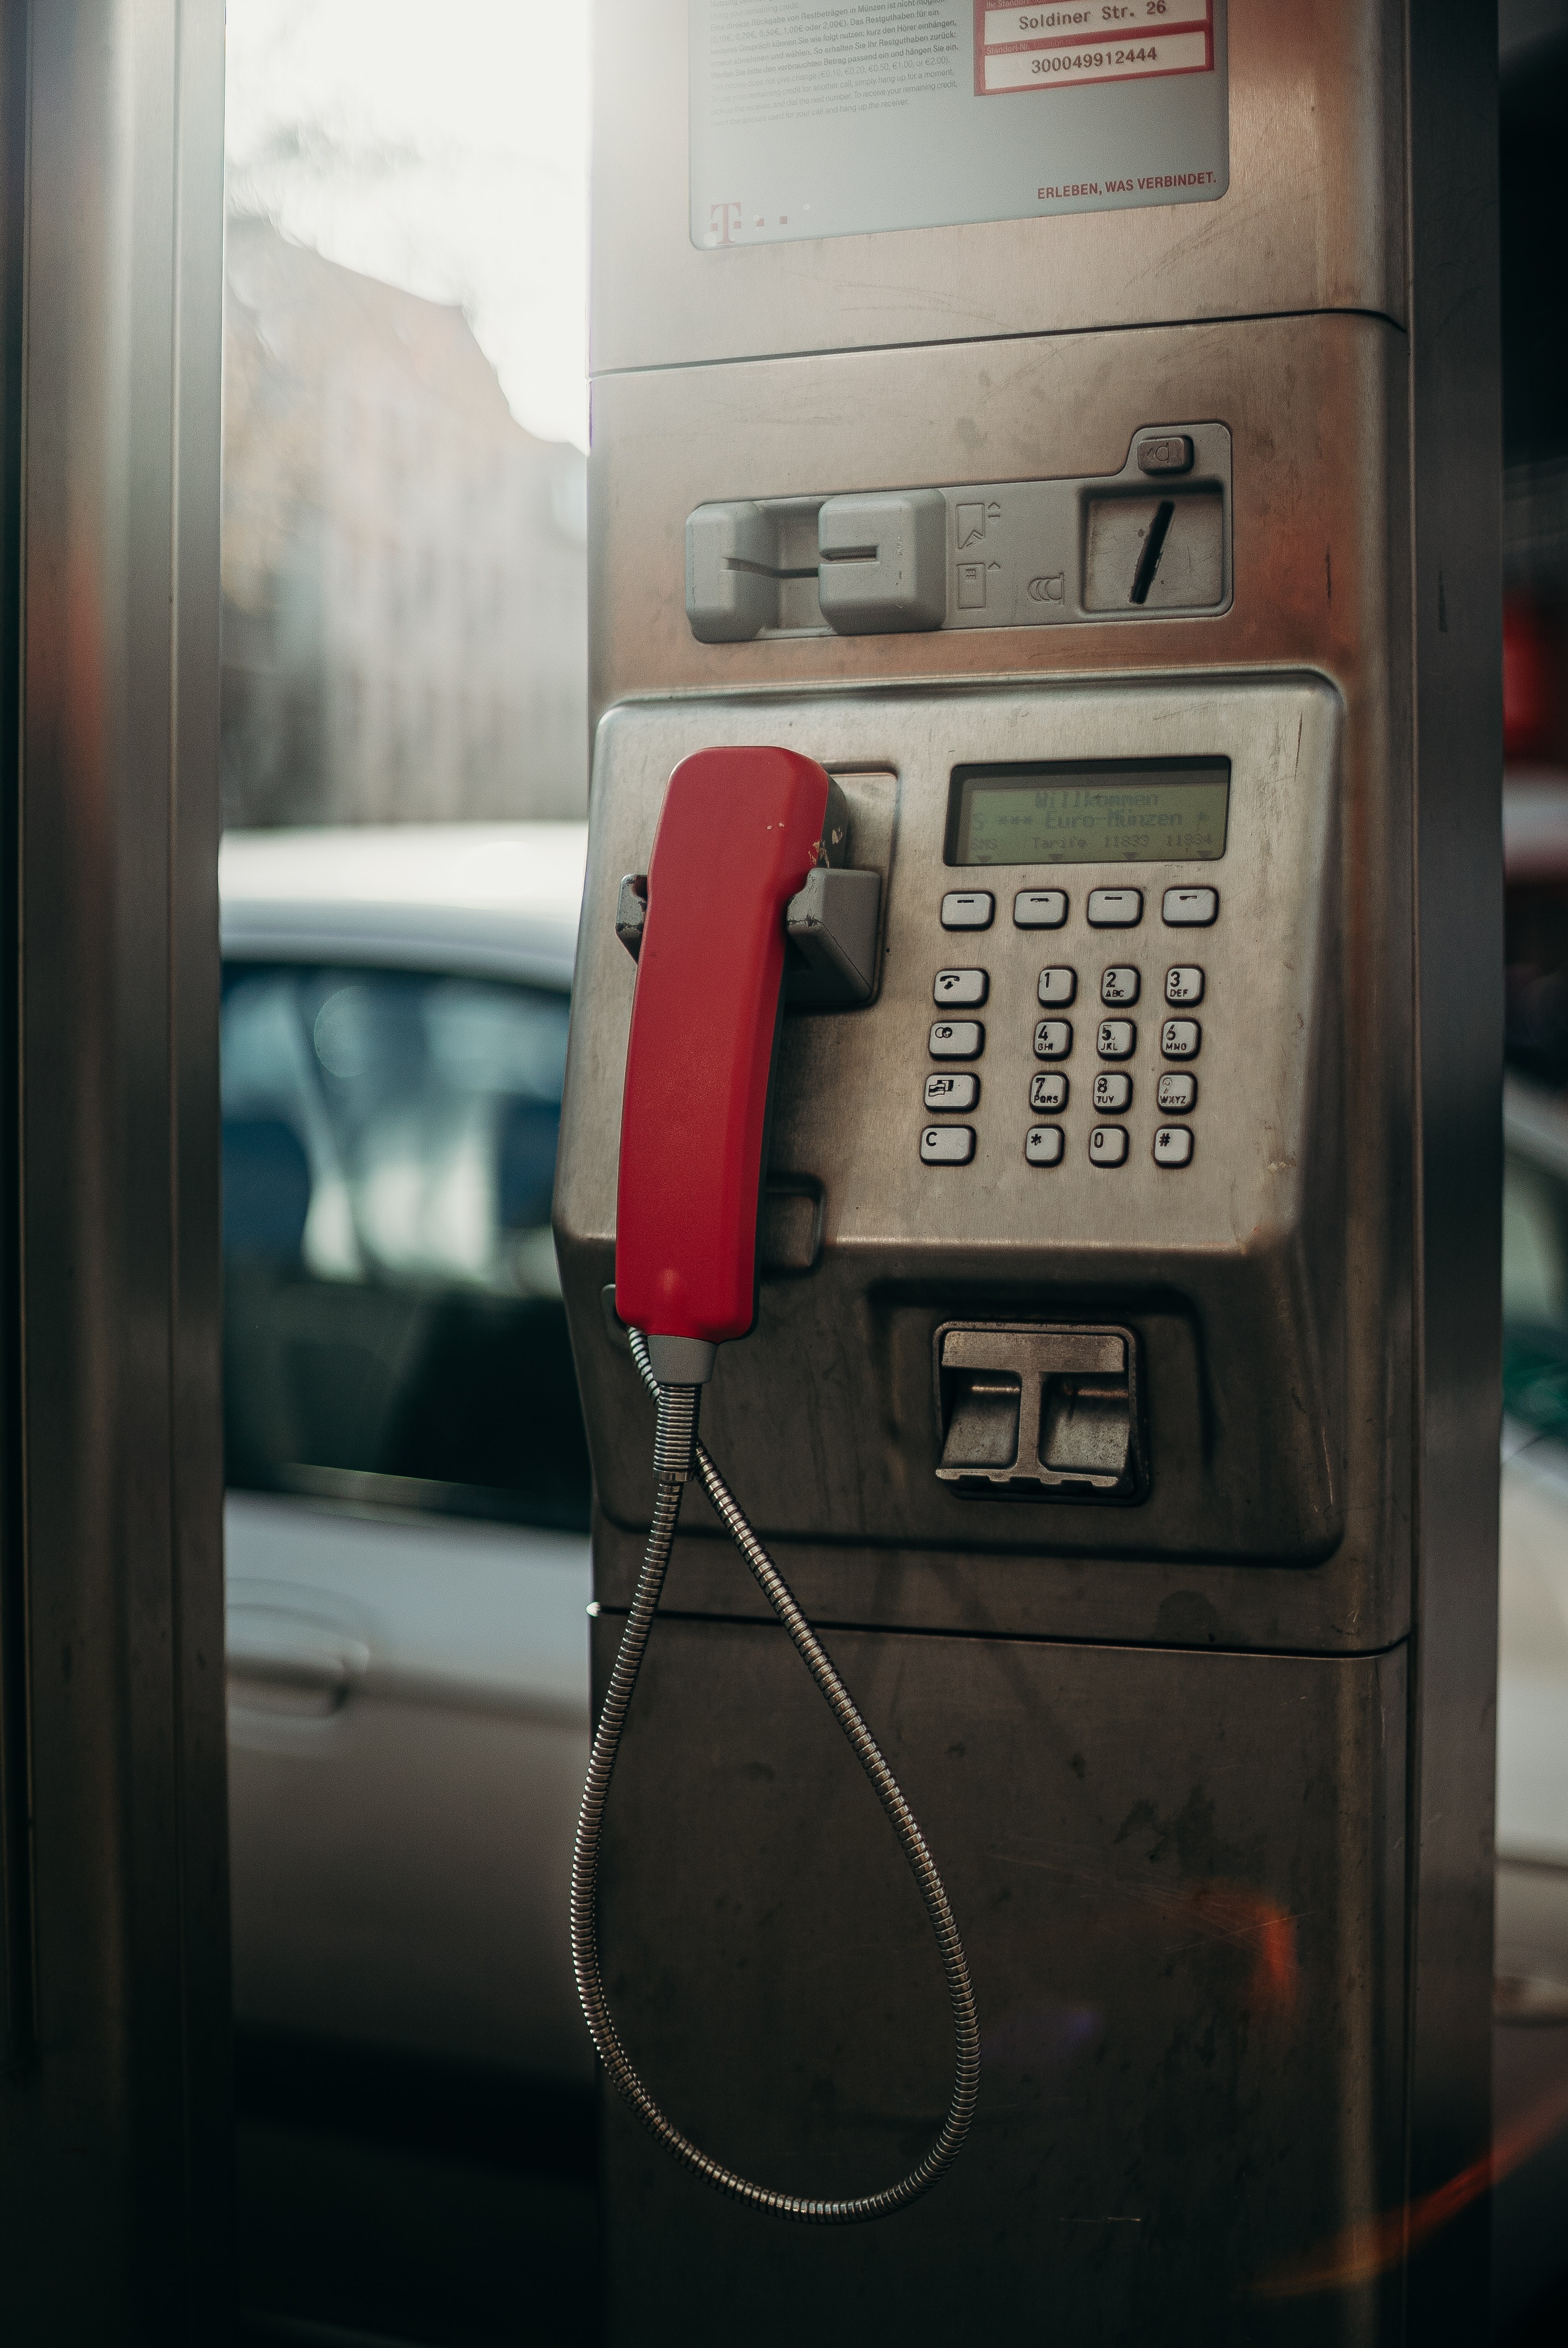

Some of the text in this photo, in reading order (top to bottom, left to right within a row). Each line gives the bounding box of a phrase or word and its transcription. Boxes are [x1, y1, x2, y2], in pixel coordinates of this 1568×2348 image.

[710, 23, 725, 31] Eine
[726, 19, 750, 29] direkte
[751, 16, 785, 26] Rückgabe
[801, 9, 848, 20] Restbeträgen
[858, 4, 885, 13] Münzen
[887, 2, 896, 10] ist
[898, 0, 915, 8] nicht
[730, 11, 743, 19] your
[745, 6, 778, 16] remaining
[780, 2, 798, 12] credit
[1019, 0, 1167, 30] Soldiner Str. 26
[710, 33, 734, 44] (0,10€,
[735, 30, 757, 41] 0,20€,
[759, 28, 782, 38] 0,50€,
[783, 25, 803, 35] 1,00€
[805, 23, 821, 32] oder
[822, 20, 848, 30] 2,00€).
[865, 12, 915, 24] Restguthaben
[710, 47, 737, 55] weiteres
[739, 41, 770, 52] Gespräch
[772, 39, 797, 48] können
[798, 37, 808, 45] Sie
[810, 35, 822, 43] wie
[823, 33, 838, 42] folgt
[840, 31, 864, 40] nutzen:
[918, 20, 957, 30] einhängen,
[710, 58, 732, 68] erneut
[733, 55, 769, 65] abnehmen
[770, 52, 783, 60] und
[785, 49, 812, 58] wählen.
[825, 44, 853, 54] erhalten
[868, 40, 877, 49] Ihr
[879, 35, 929, 47] Restguthaben
[930, 31, 956, 41] zurück:
[987, 43, 1029, 55] Standort-Nr.
[710, 70, 734, 80] Werfen
[747, 66, 762, 75] bitte
[777, 60, 822, 71] verbrauchten
[824, 58, 846, 66] Betrag
[848, 53, 876, 65] passend
[890, 49, 904, 58] und
[905, 48, 931, 56] hängen
[933, 45, 944, 53] Sie
[1031, 47, 1157, 74] 300049912444
[711, 84, 724, 92] This
[725, 82, 746, 91] phone
[765, 77, 776, 85] not
[777, 76, 791, 85] give
[792, 74, 817, 82] change
[818, 69, 842, 80] (€0.10,
[844, 66, 866, 76] €0.20,
[868, 64, 890, 73] €0.50,
[892, 60, 915, 70] €1.00,
[925, 56, 950, 66] €2.00).
[733, 94, 746, 103] your
[748, 89, 781, 99] remaining
[782, 86, 801, 95] credit
[813, 83, 838, 91] another
[839, 80, 853, 89] call,
[855, 77, 876, 87] simply
[924, 68, 954, 78] moment,
[746, 103, 771, 112] receiver,
[772, 100, 785, 109] and
[786, 98, 797, 107] dial
[811, 95, 824, 104] next
[826, 93, 852, 102] number.
[863, 89, 885, 97] receive
[886, 87, 901, 96] your
[903, 83, 936, 93] remaining
[937, 79, 957, 89] credit,
[741, 114, 766, 125] amount
[768, 112, 783, 121] used
[796, 111, 811, 120] your
[812, 107, 823, 116] call
[825, 106, 838, 115] and
[881, 99, 909, 107] receiver.
[1037, 171, 1217, 199] ERLEBEN, WAS VERBINDET.
[1034, 790, 1159, 808] Willkommen
[1045, 809, 1183, 830] Euro-Münzen
[1031, 836, 1087, 849] Tarife
[1044, 972, 1050, 988] 1
[1106, 971, 1116, 988] 2
[1170, 971, 1180, 987] 3
[1038, 1025, 1048, 1041] 4
[1102, 1025, 1112, 1041] 5
[1166, 1024, 1176, 1041] 6
[1038, 1043, 1053, 1051] GHI
[1035, 1078, 1045, 1096] 7
[1097, 1078, 1107, 1094] 8
[1163, 1077, 1173, 1094] 9
[1034, 1095, 1059, 1104] PQRS
[1096, 1095, 1114, 1104] TUV
[1160, 1095, 1186, 1104] WXYZ
[926, 1131, 937, 1147] C
[1094, 1132, 1103, 1148] 0
